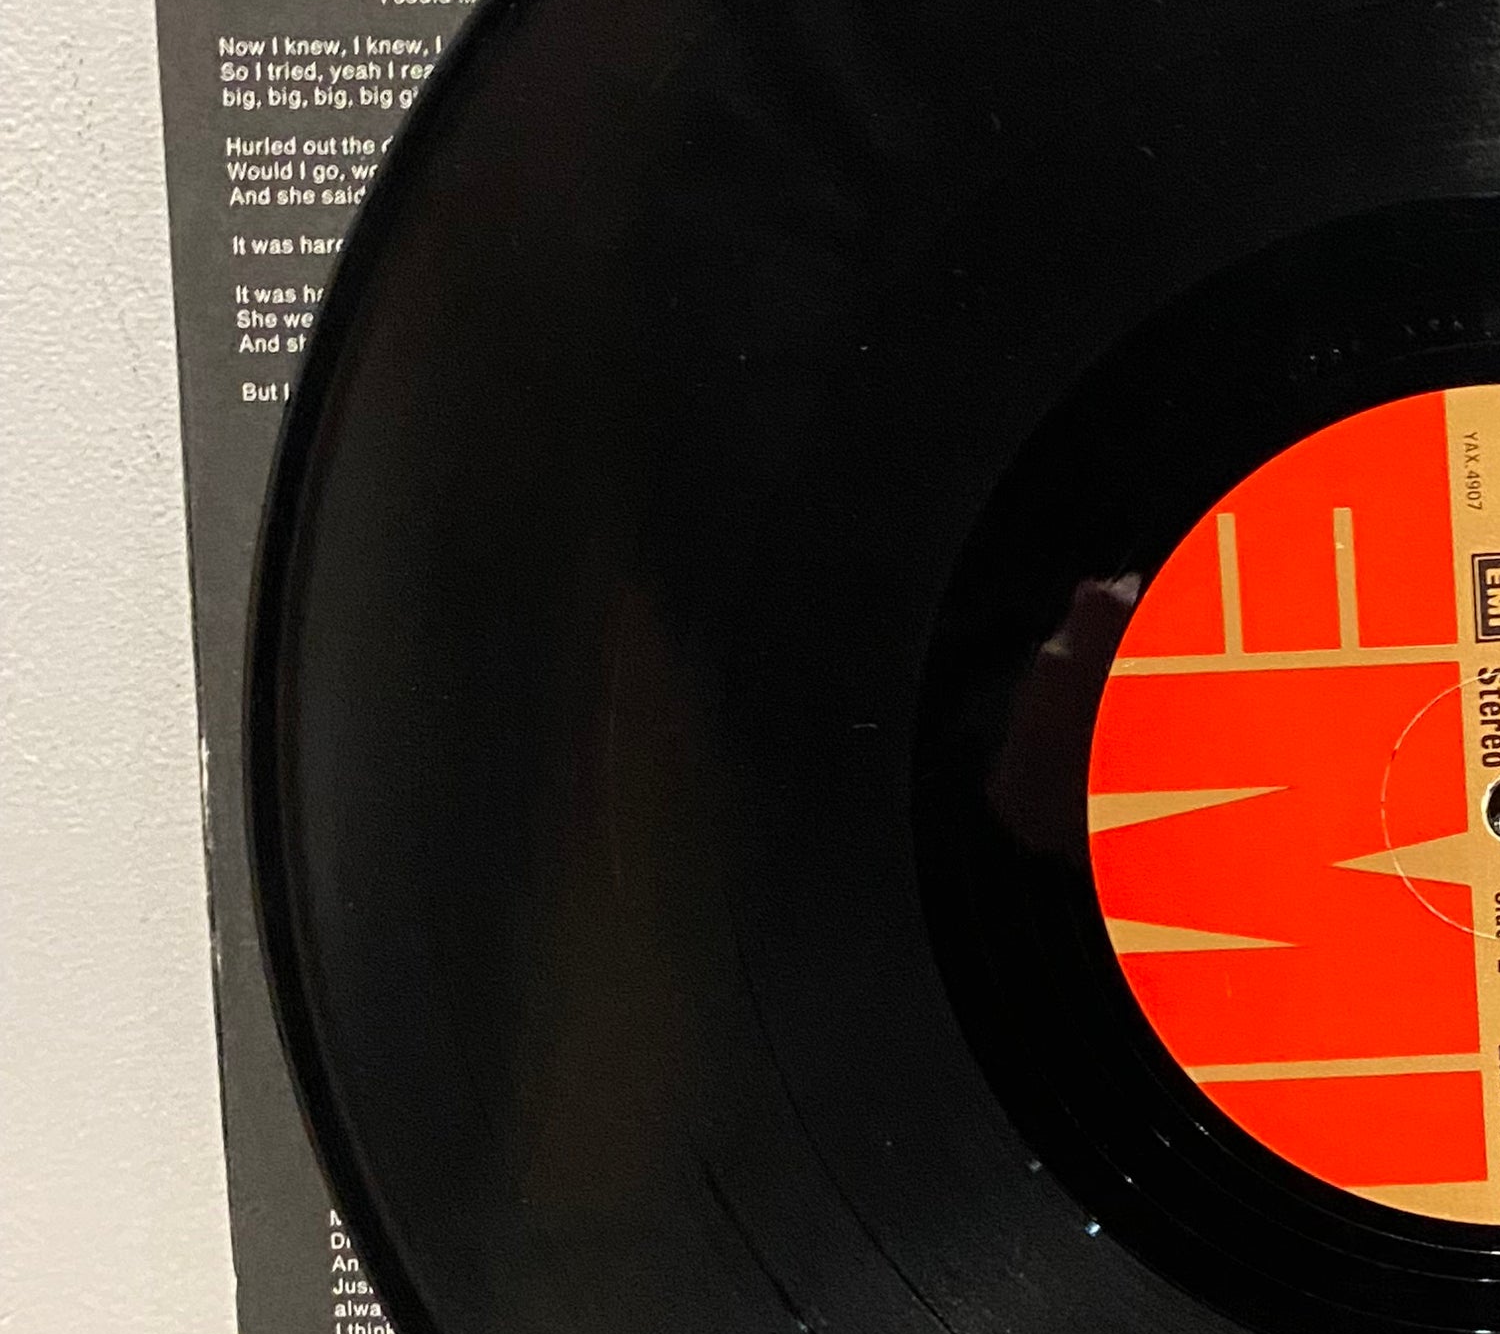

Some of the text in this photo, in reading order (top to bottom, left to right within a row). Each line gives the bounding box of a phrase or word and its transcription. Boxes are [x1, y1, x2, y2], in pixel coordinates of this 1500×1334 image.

[225, 135, 375, 157] Hurled out the
